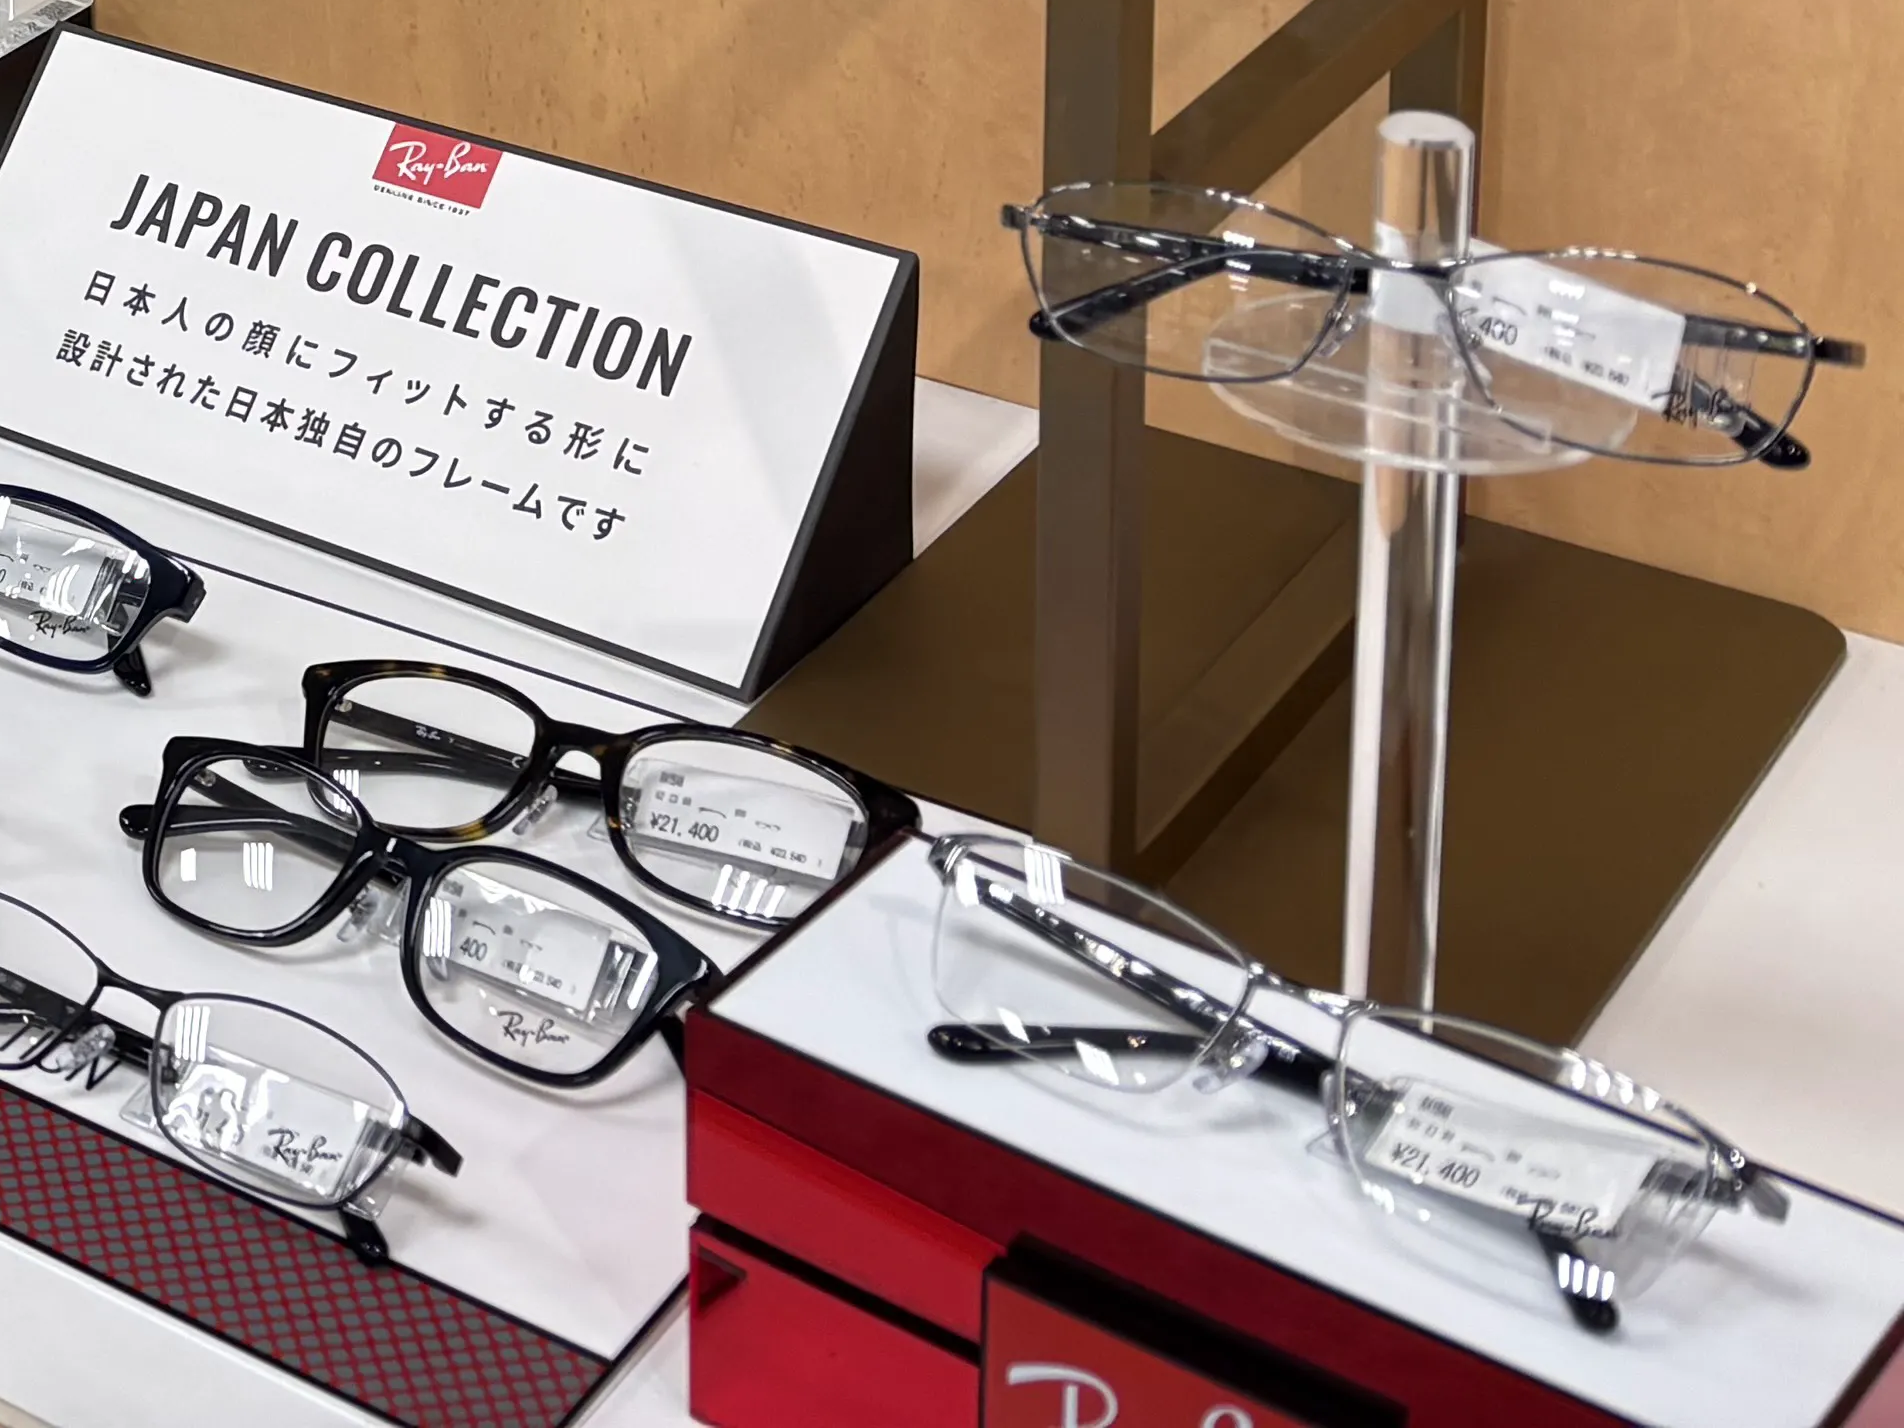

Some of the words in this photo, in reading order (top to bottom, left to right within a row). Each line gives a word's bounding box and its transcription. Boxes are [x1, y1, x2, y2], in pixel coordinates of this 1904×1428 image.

[83, 270, 653, 477] 日本人の顔にフィットする形に
[110, 173, 298, 277] JAPAN
[306, 231, 694, 399] COLLECTION
[56, 328, 627, 542] 設計された日本独自のフレームです
